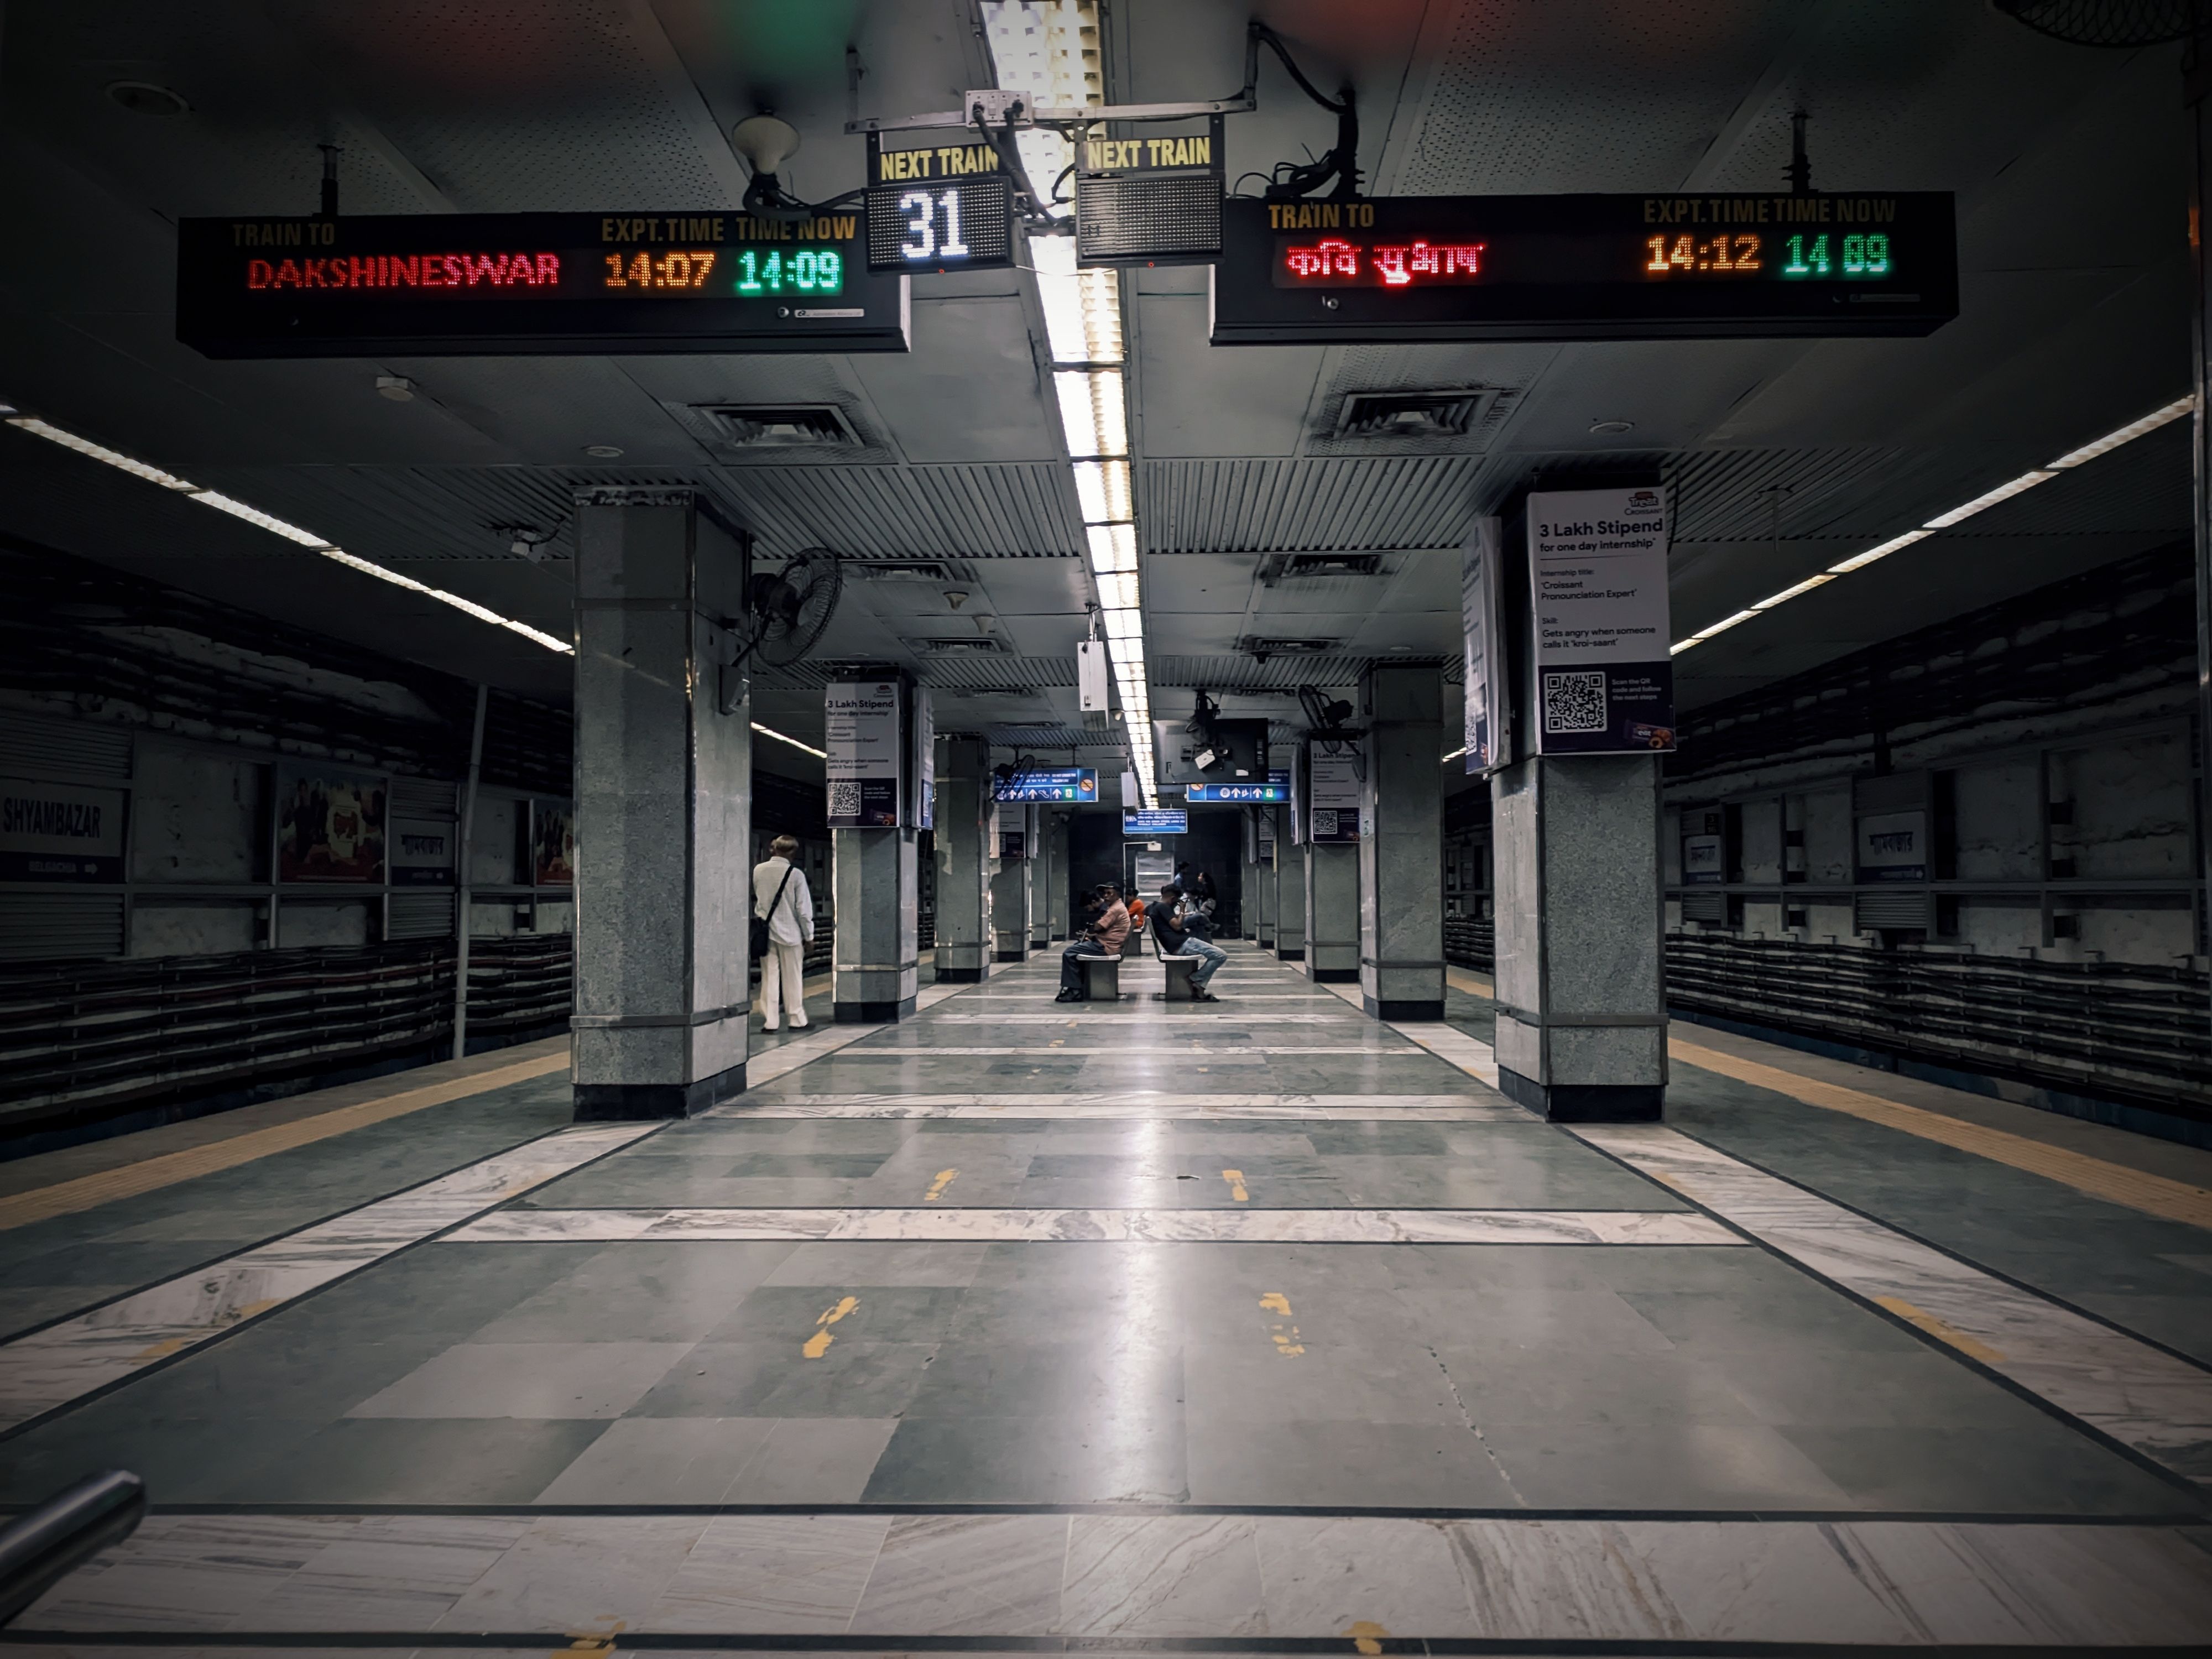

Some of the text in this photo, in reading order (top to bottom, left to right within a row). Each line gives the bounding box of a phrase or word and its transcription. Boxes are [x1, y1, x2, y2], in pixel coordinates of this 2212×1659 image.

[881, 145, 998, 180] NEXT TRAIN
[1088, 137, 1211, 169] NEXT TRAIN
[1269, 204, 1374, 229] TRAIN TO
[1773, 198, 1830, 222] TIME
[1837, 199, 1896, 222] NOW
[233, 223, 335, 247] TRAIN TO
[736, 217, 791, 241] TIME
[797, 216, 856, 240] NOW
[900, 190, 968, 259] 31
[1287, 241, 1361, 275] कवि
[1648, 234, 1760, 270] 14:12
[248, 252, 559, 290] DAKSHINESWAR
[605, 252, 715, 288] 14:07
[735, 251, 840, 289] 14:09
[1540, 518, 1663, 538] 3 Lakh Stipend
[1540, 544, 1554, 552] for
[1557, 543, 1576, 551] one
[1578, 541, 1598, 552] day
[1540, 568, 1577, 577] Internship
[1542, 629, 1563, 638] Gets
[1565, 629, 1589, 638] angry
[1591, 628, 1615, 636] when
[859, 700, 894, 709] Stipend
[4, 797, 101, 838] SHYAMBAZAR
